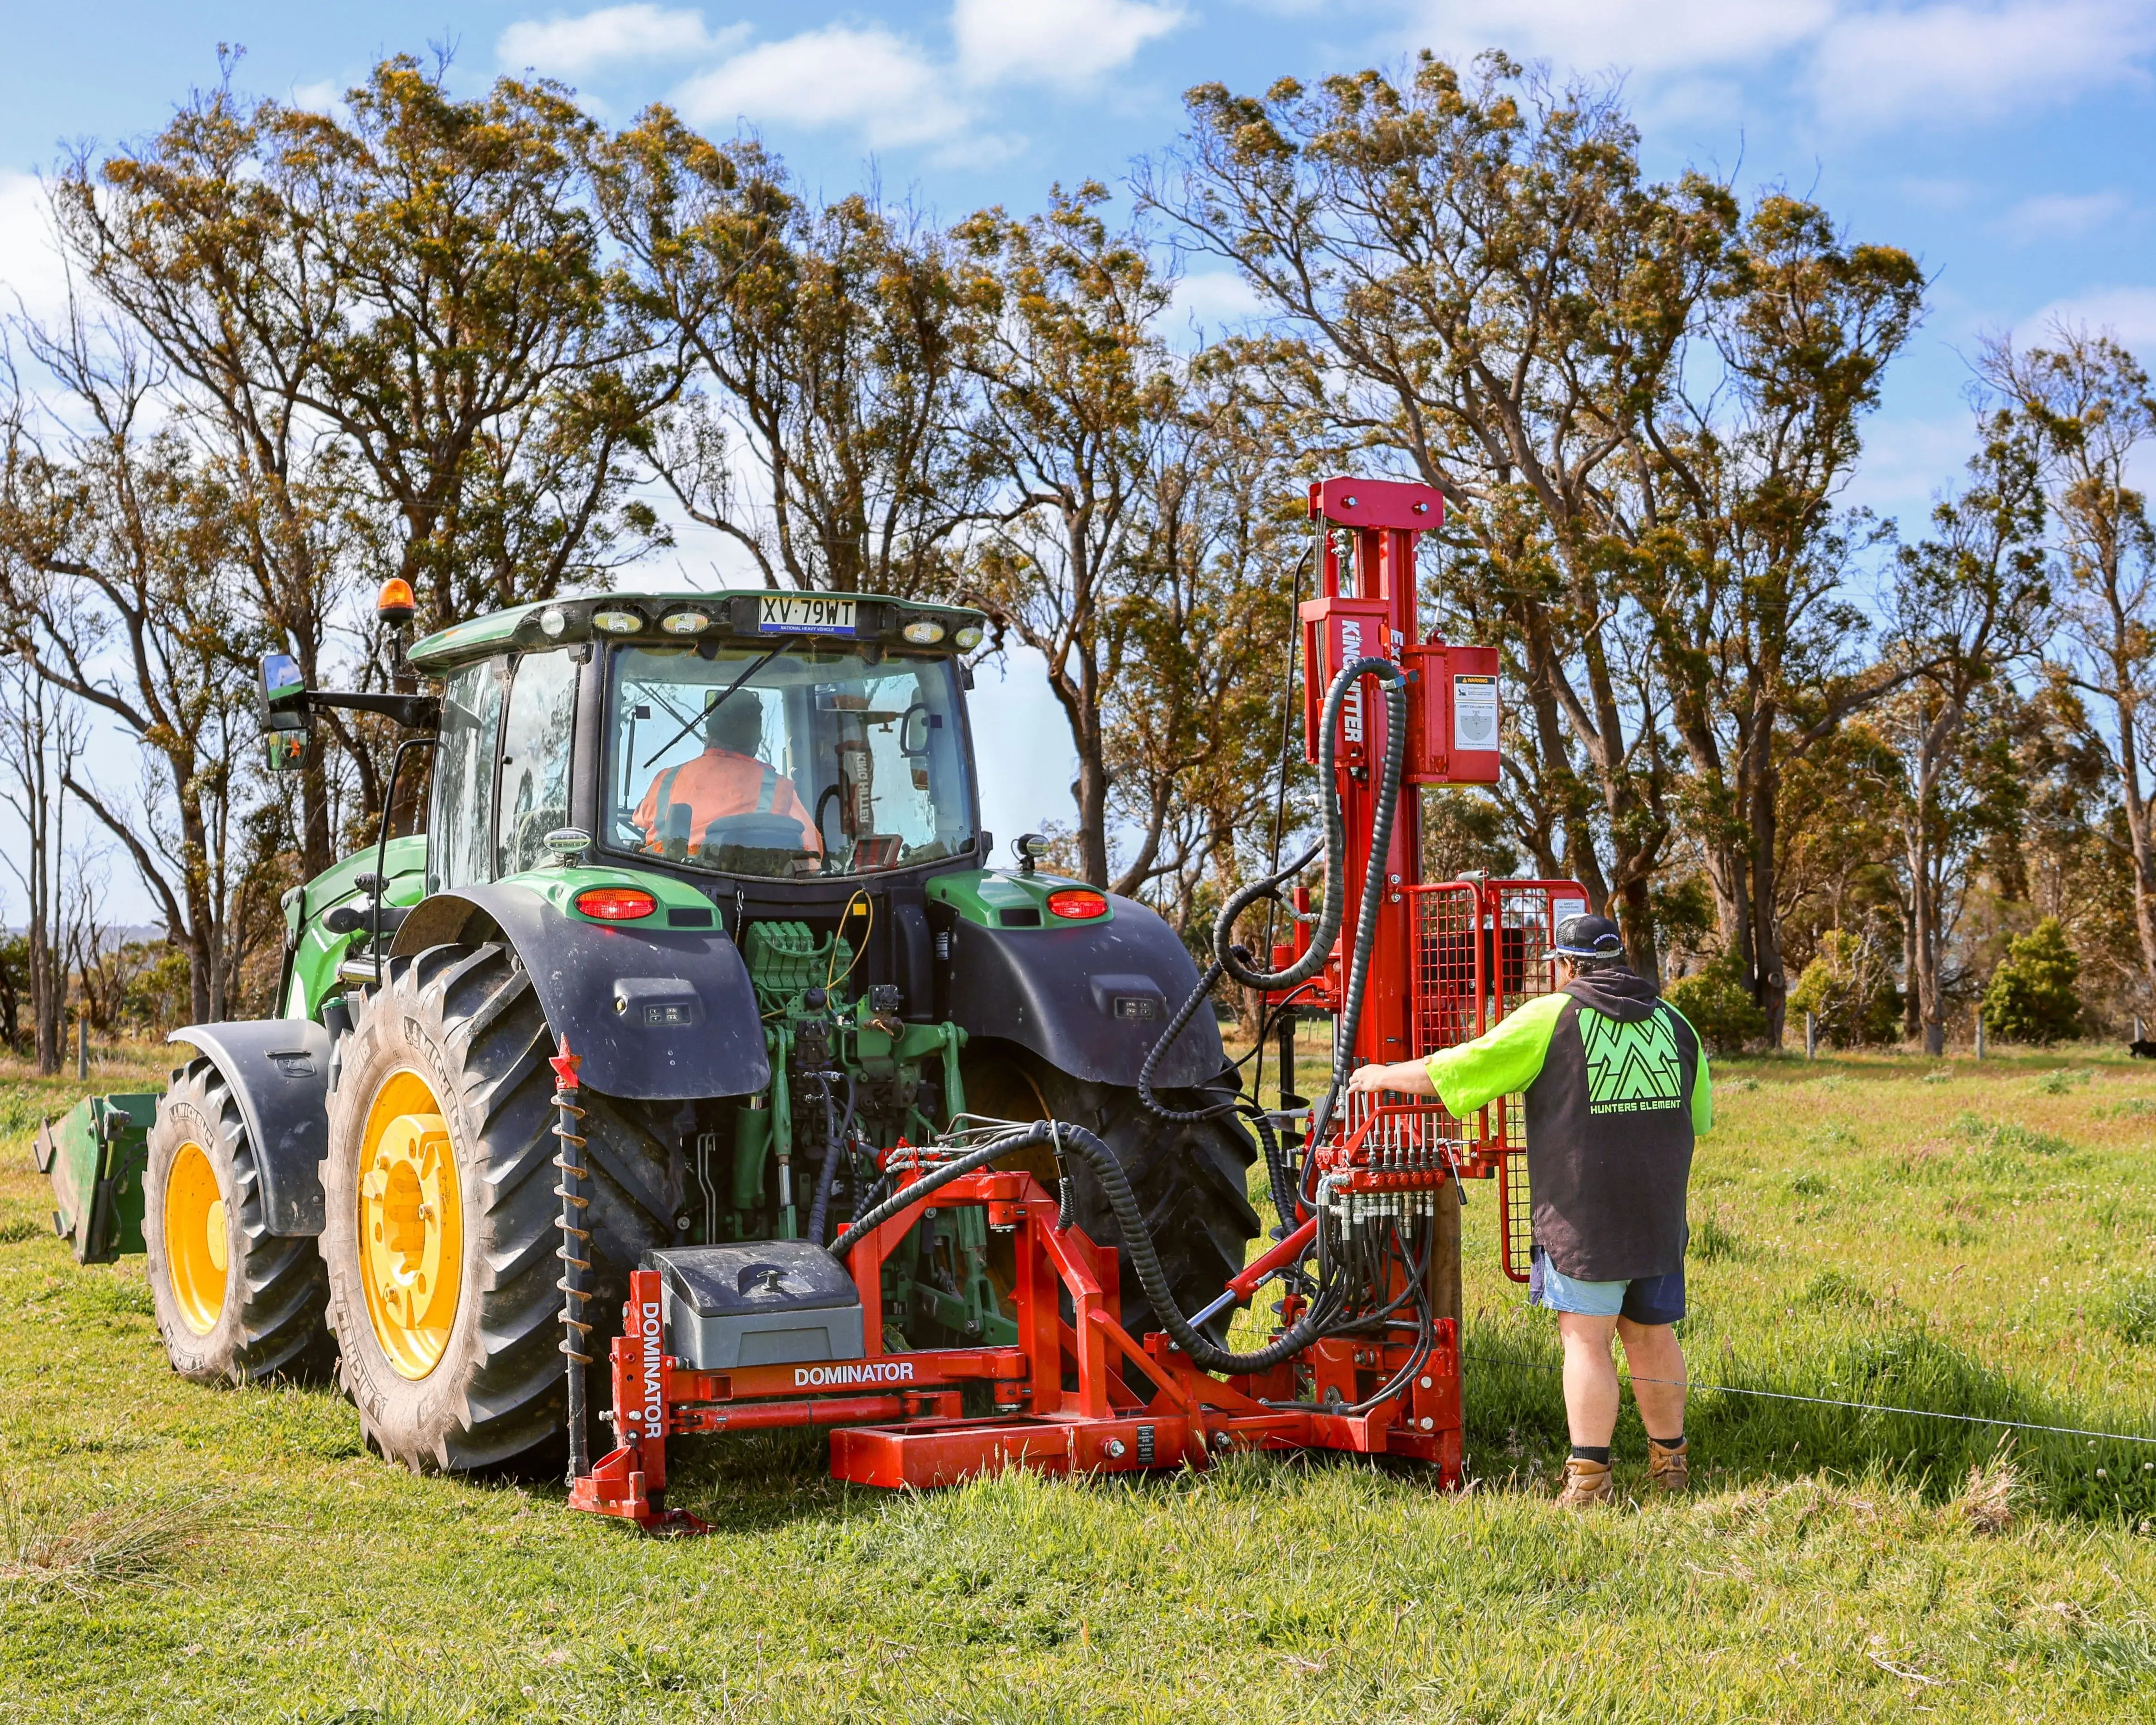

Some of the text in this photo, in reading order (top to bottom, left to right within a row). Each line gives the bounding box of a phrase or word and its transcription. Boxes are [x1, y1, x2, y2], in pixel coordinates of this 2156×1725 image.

[1590, 1100, 1681, 1114] HUNTERS ELEMENT
[642, 1302, 662, 1438] DOMINATOR
[795, 1362, 913, 1386] DOMINATOR
